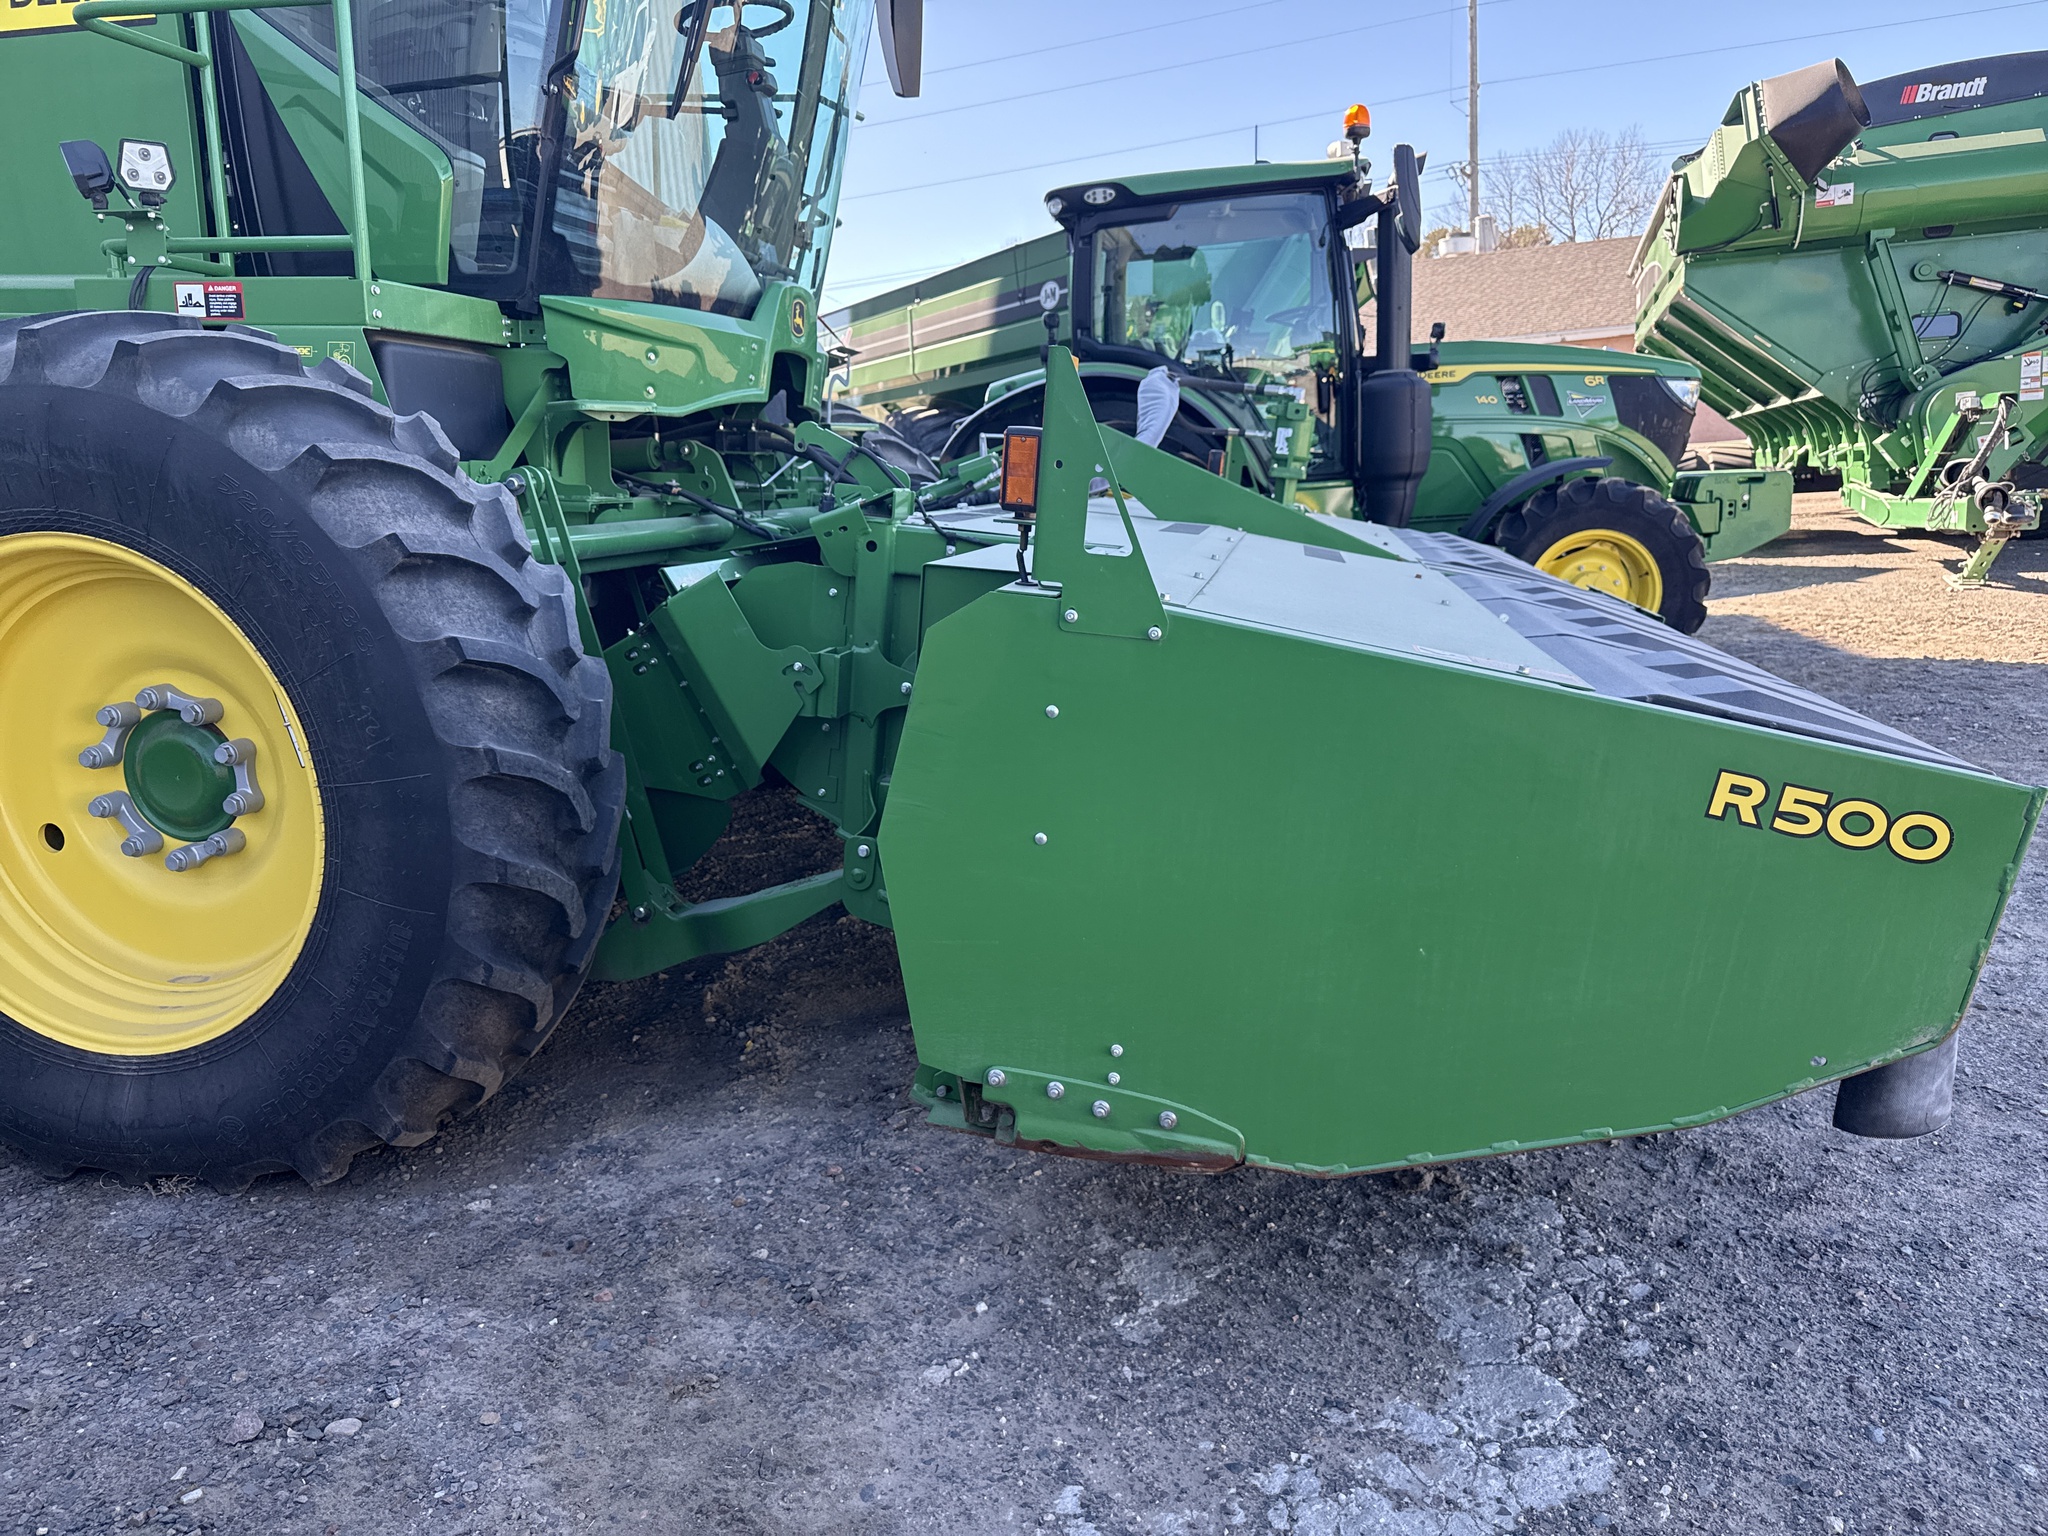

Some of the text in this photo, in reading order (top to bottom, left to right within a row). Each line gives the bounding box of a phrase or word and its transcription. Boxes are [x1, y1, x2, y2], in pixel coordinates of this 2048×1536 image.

[1915, 77, 1987, 103] Brandt
[1420, 370, 1456, 379] DEERE
[1584, 375, 1605, 387] 6R
[1474, 395, 1498, 404] 140
